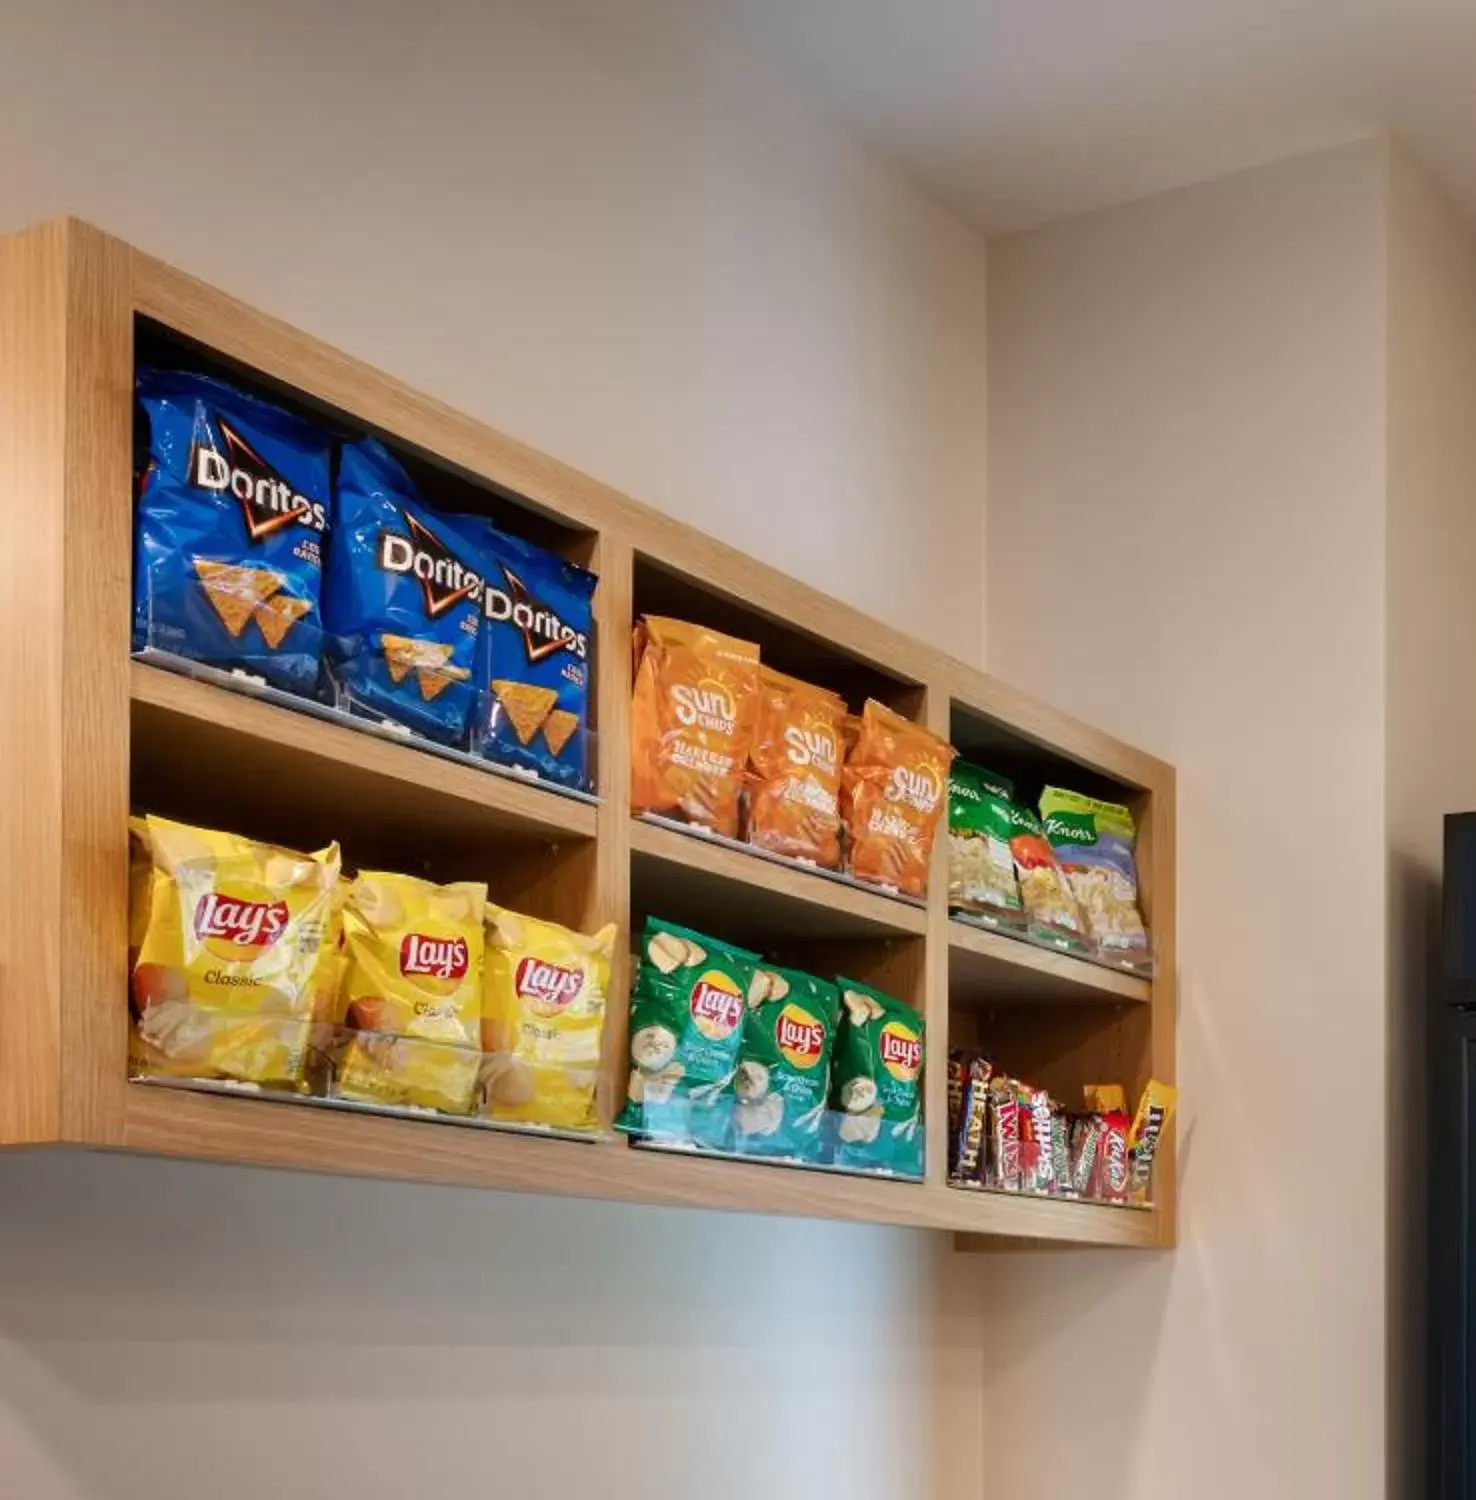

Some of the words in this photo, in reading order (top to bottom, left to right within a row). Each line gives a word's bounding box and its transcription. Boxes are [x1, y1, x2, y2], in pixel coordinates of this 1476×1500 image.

[196, 446, 326, 533] Doritos
[485, 587, 588, 658] Doritos
[1045, 817, 1095, 842] Knorr
[198, 893, 288, 945] Lay's
[203, 969, 262, 987] Classic
[402, 933, 466, 979] Lay's
[516, 959, 584, 1004] Lay's
[694, 983, 743, 1026] Lay's
[779, 1018, 823, 1054] Lay's
[883, 1036, 921, 1068] Lay's
[960, 1079, 988, 1167] HEATH
